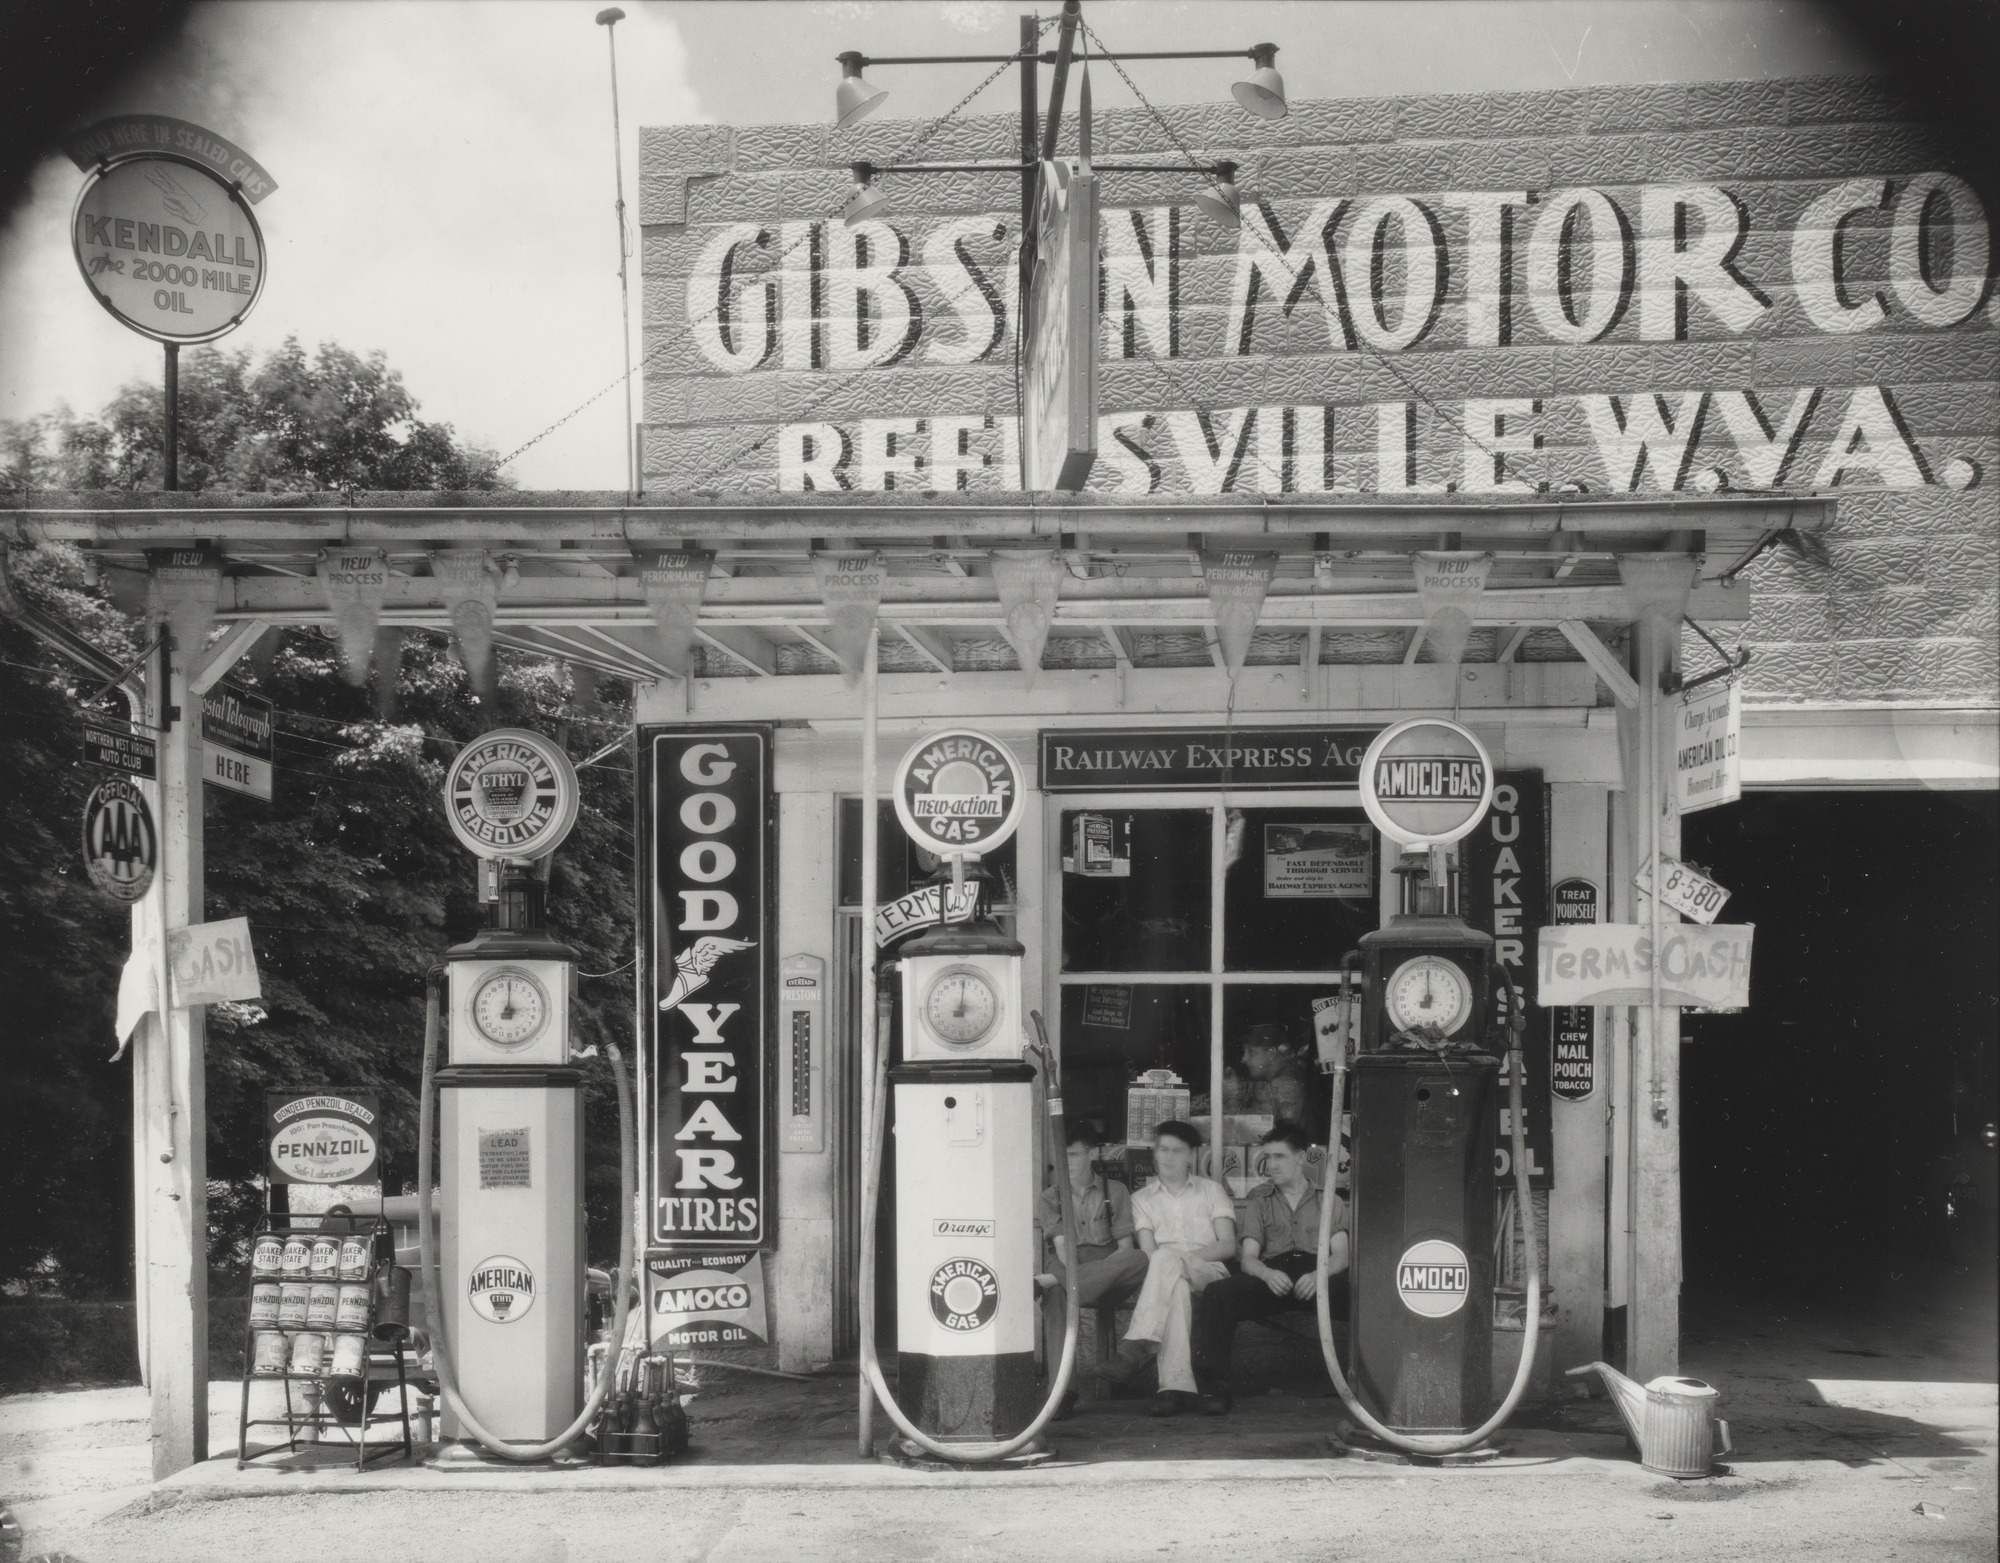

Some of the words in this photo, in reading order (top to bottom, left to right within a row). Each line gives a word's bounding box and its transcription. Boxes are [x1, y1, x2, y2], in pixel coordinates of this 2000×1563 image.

[175, 129, 228, 166] SEALED
[229, 158, 268, 196] CANS
[84, 213, 255, 268] KENDALL
[88, 252, 125, 277] The
[133, 258, 198, 287] 2000
[202, 268, 252, 295] MILE
[687, 206, 1180, 373] GIBSN
[1223, 185, 1773, 356] MOTOR
[1790, 171, 1991, 333] CO
[154, 289, 194, 314] OIL
[779, 398, 1589, 494] REESVILLE.
[172, 551, 204, 567] NEW
[341, 556, 372, 571] NEW
[657, 553, 690, 569] NEW
[837, 557, 869, 573] NEW
[1223, 553, 1255, 567] NEW
[1437, 559, 1470, 574] NEW
[157, 567, 219, 581] PERFORMANCE
[328, 572, 384, 587] PROCESS
[642, 570, 705, 584] PERFORMANCE
[824, 573, 880, 588] PROCESS
[1206, 568, 1269, 582] PERFORMANCE
[1424, 575, 1481, 589] PROCESS
[202, 694, 226, 720] ostal
[227, 695, 270, 741] Telegraph
[86, 728, 114, 748] NORTHERN
[115, 737, 129, 752] WEST
[100, 747, 120, 765] AUTO
[122, 753, 142, 769] CLUB
[1054, 746, 1178, 771] RAILWAY
[1186, 744, 1312, 768] EXPRESS
[1322, 743, 1364, 767] AG
[1678, 740, 1713, 771] AMERICAN
[1715, 737, 1725, 761] OIL
[216, 754, 250, 785] HERE
[459, 743, 552, 785] AMERICAN
[912, 739, 1012, 797] AMERICAN
[481, 773, 525, 788] ETHYL
[1378, 762, 1482, 797] AMOCO-GAS
[98, 781, 143, 814] OFFICIAL
[917, 795, 1000, 815] new-action
[459, 803, 553, 845] GASOLINE
[930, 816, 980, 840] GAS
[100, 801, 145, 879] AAA
[1491, 784, 1524, 967] QUAKER
[1562, 890, 1591, 900] TREAT
[1666, 869, 1721, 912] 8-580
[1556, 903, 1596, 919] YOURSELF
[788, 978, 815, 986] EVEREADY
[781, 989, 822, 1001] PRESTONE
[1560, 1032, 1588, 1041] CHEW
[1557, 1045, 1589, 1059] MAIL
[1554, 1062, 1592, 1077] POUCH
[1554, 1080, 1591, 1090] TOBACCO
[275, 1101, 305, 1121] BONDED
[306, 1098, 342, 1109] PENNZOIL
[344, 1101, 373, 1122] DEALER
[322, 1122, 359, 1137] Pennsylvania
[278, 1139, 369, 1159] PENNZOIL
[491, 1138, 518, 1147] LEAD
[1495, 1149, 1544, 1176] OL
[310, 1167, 355, 1179] Lubrication
[659, 1197, 758, 1232] TIRES
[938, 1221, 991, 1236] Orange
[259, 1255, 279, 1264] STATE
[651, 1258, 692, 1271] QUALITY
[702, 1254, 747, 1267] ECONOMY
[469, 1269, 532, 1295] AMERICAN
[931, 1261, 997, 1296] AMERICAN
[1402, 1267, 1465, 1290] AMOCO
[342, 1297, 369, 1306] PENNZO
[658, 1287, 748, 1313] AMOCO
[945, 1313, 980, 1329] GAS
[668, 1330, 719, 1345] MOTOR
[723, 1328, 748, 1342] OIL
